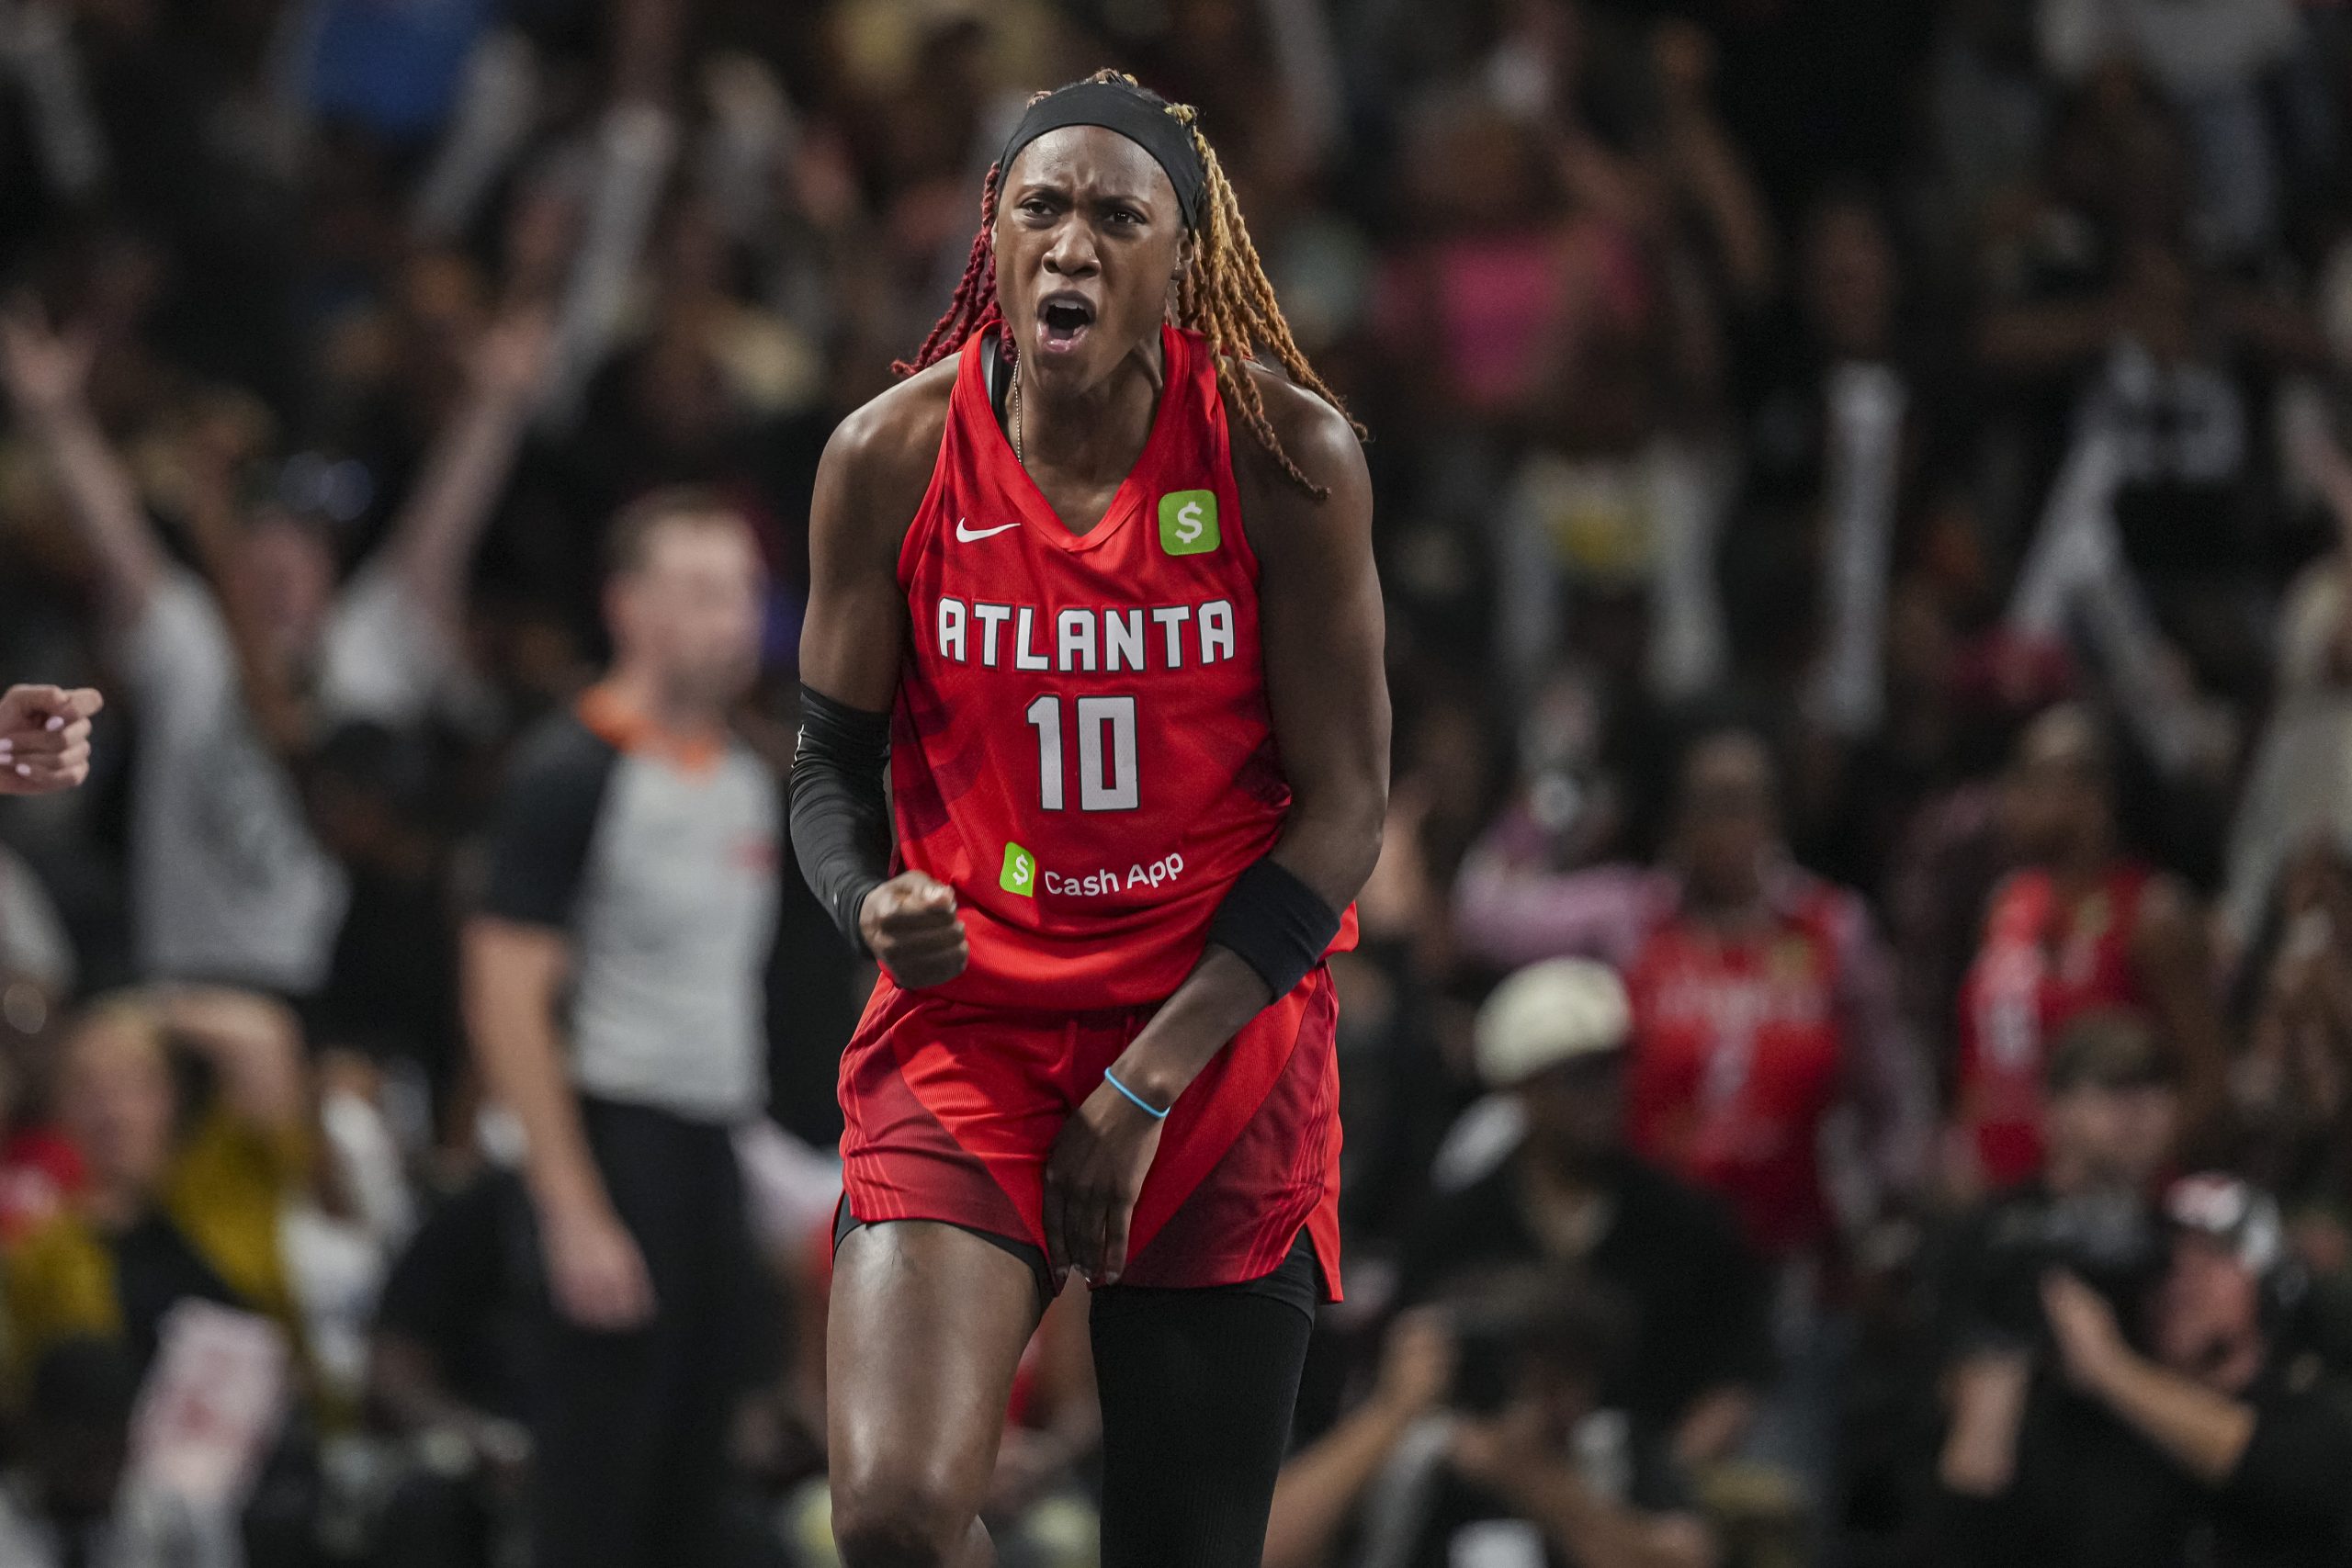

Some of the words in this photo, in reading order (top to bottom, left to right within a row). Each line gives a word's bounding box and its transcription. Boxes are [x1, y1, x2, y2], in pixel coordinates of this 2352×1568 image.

[937, 596, 1235, 672] ATLANTA
[1025, 694, 1140, 812] 10
[1045, 868, 1120, 897] Cash
[1126, 852, 1184, 889] App
